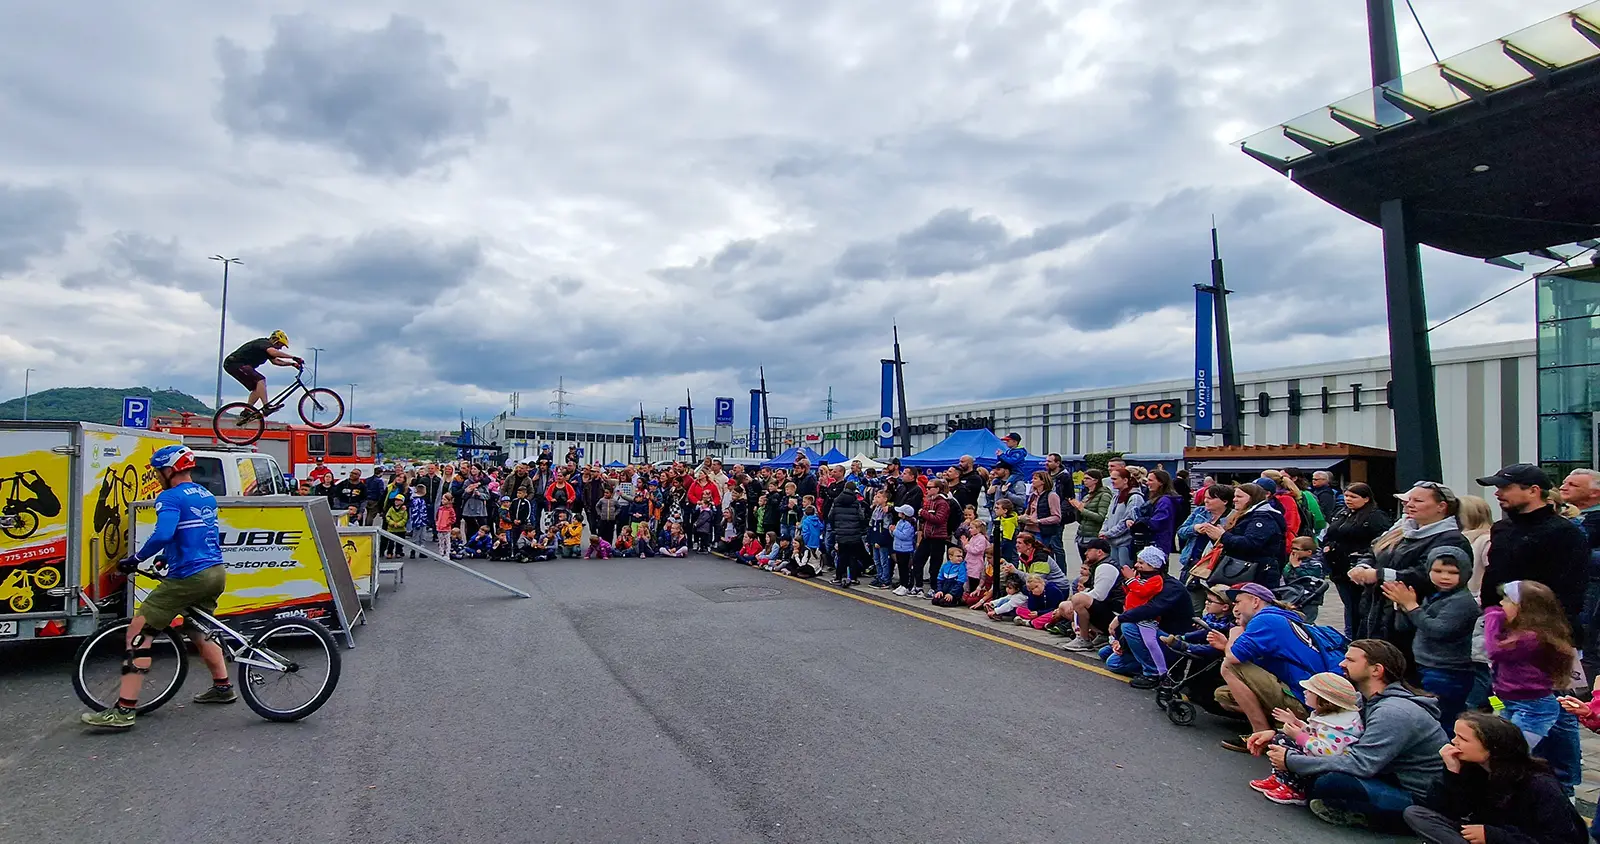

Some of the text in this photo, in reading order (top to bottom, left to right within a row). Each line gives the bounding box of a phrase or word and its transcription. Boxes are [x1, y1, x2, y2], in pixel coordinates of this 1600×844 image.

[1197, 369, 1207, 418] olympia
[128, 400, 144, 419] P
[719, 400, 730, 416] P
[1134, 403, 1172, 420] CCC
[218, 531, 303, 546] UBE
[5, 546, 55, 562] 775 231 509
[224, 560, 298, 568] e-store.cz
[275, 609, 307, 619] TRIAL
